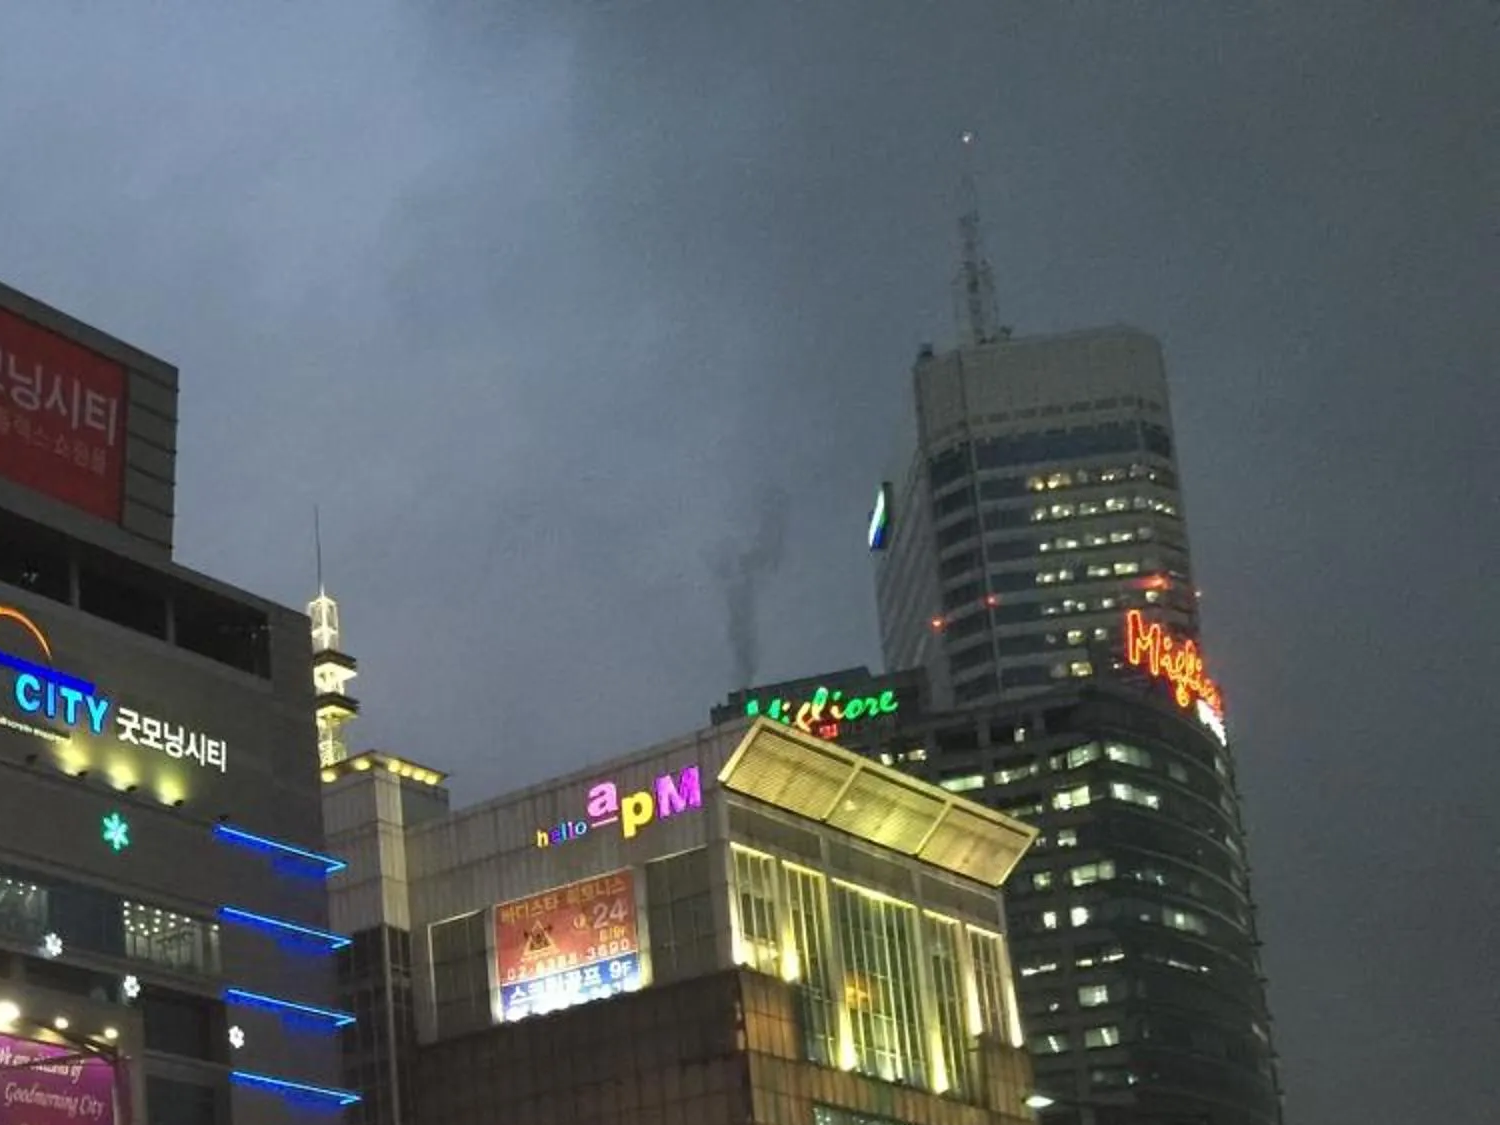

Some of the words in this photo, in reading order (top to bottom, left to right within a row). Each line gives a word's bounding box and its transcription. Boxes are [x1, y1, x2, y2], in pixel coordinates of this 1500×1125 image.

[15, 673, 109, 735] CITY
[116, 706, 227, 773] 굿모닝시티
[536, 820, 587, 848] hello
[587, 765, 702, 839] apM
[593, 897, 629, 929] 24
